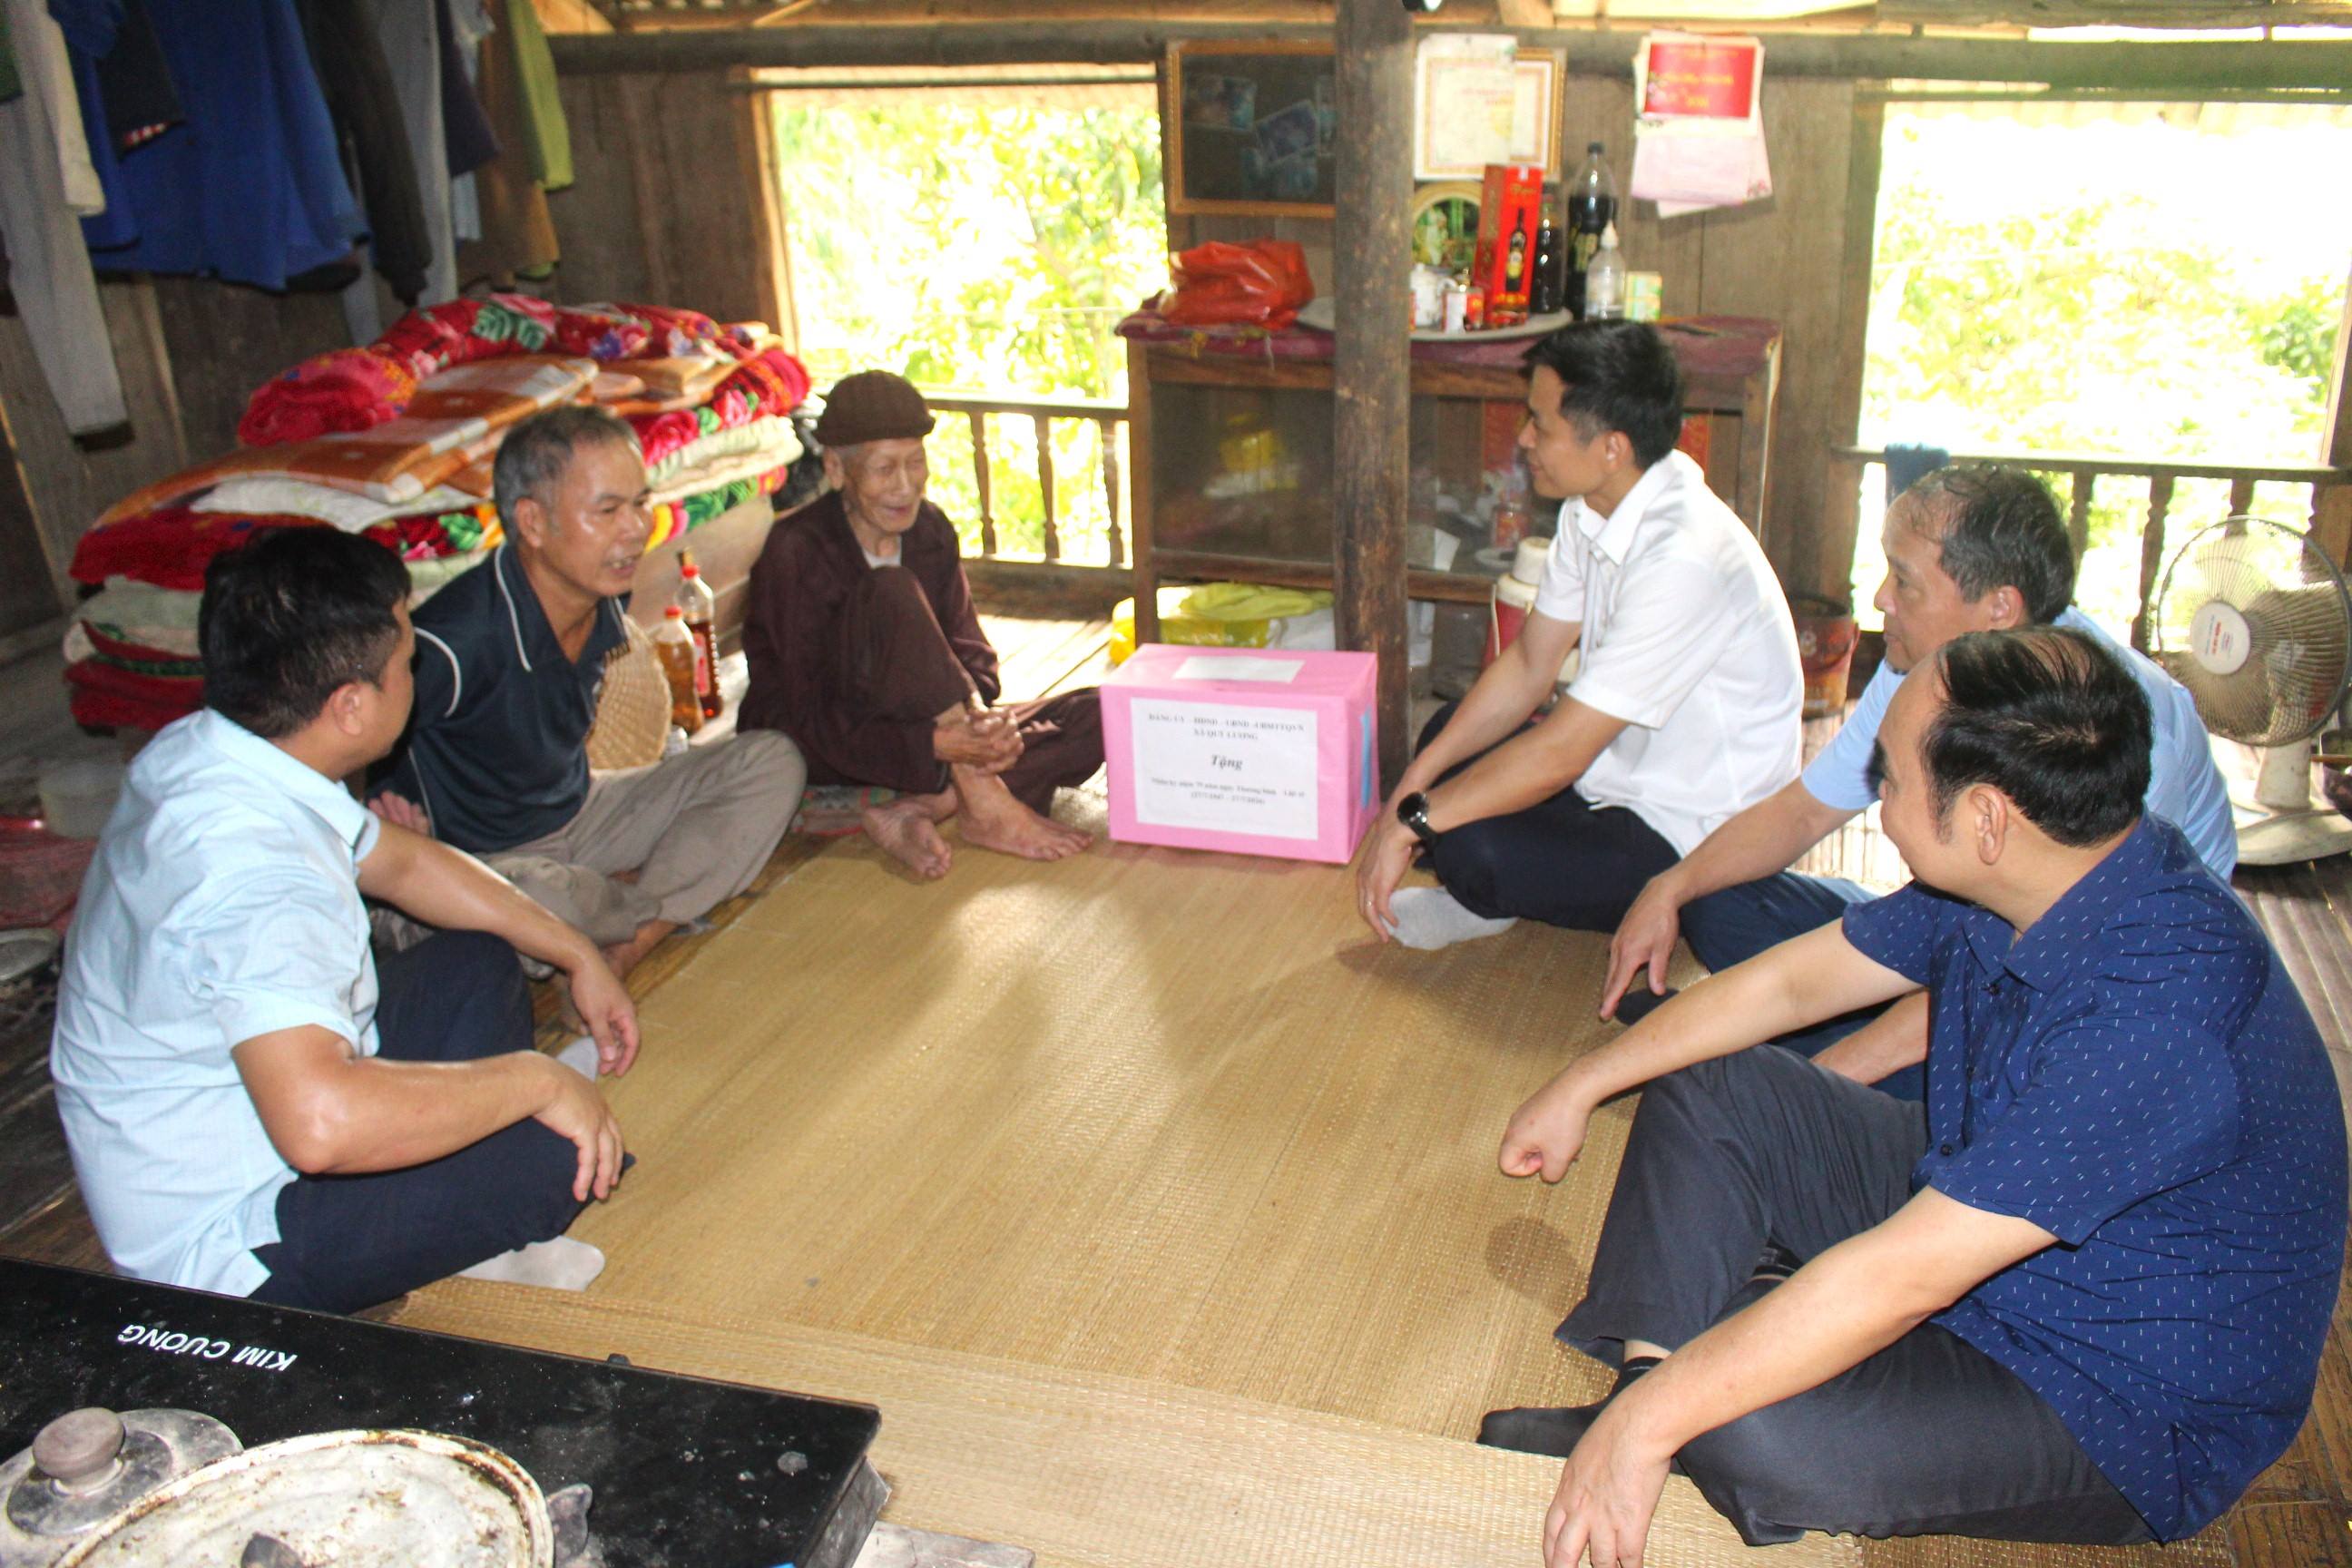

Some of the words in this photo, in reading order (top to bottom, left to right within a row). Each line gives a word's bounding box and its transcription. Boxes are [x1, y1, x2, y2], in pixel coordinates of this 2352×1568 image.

[1211, 753, 1243, 771] Tặng
[117, 1324, 231, 1359] CƯƠNG
[232, 1346, 299, 1371] KIM
